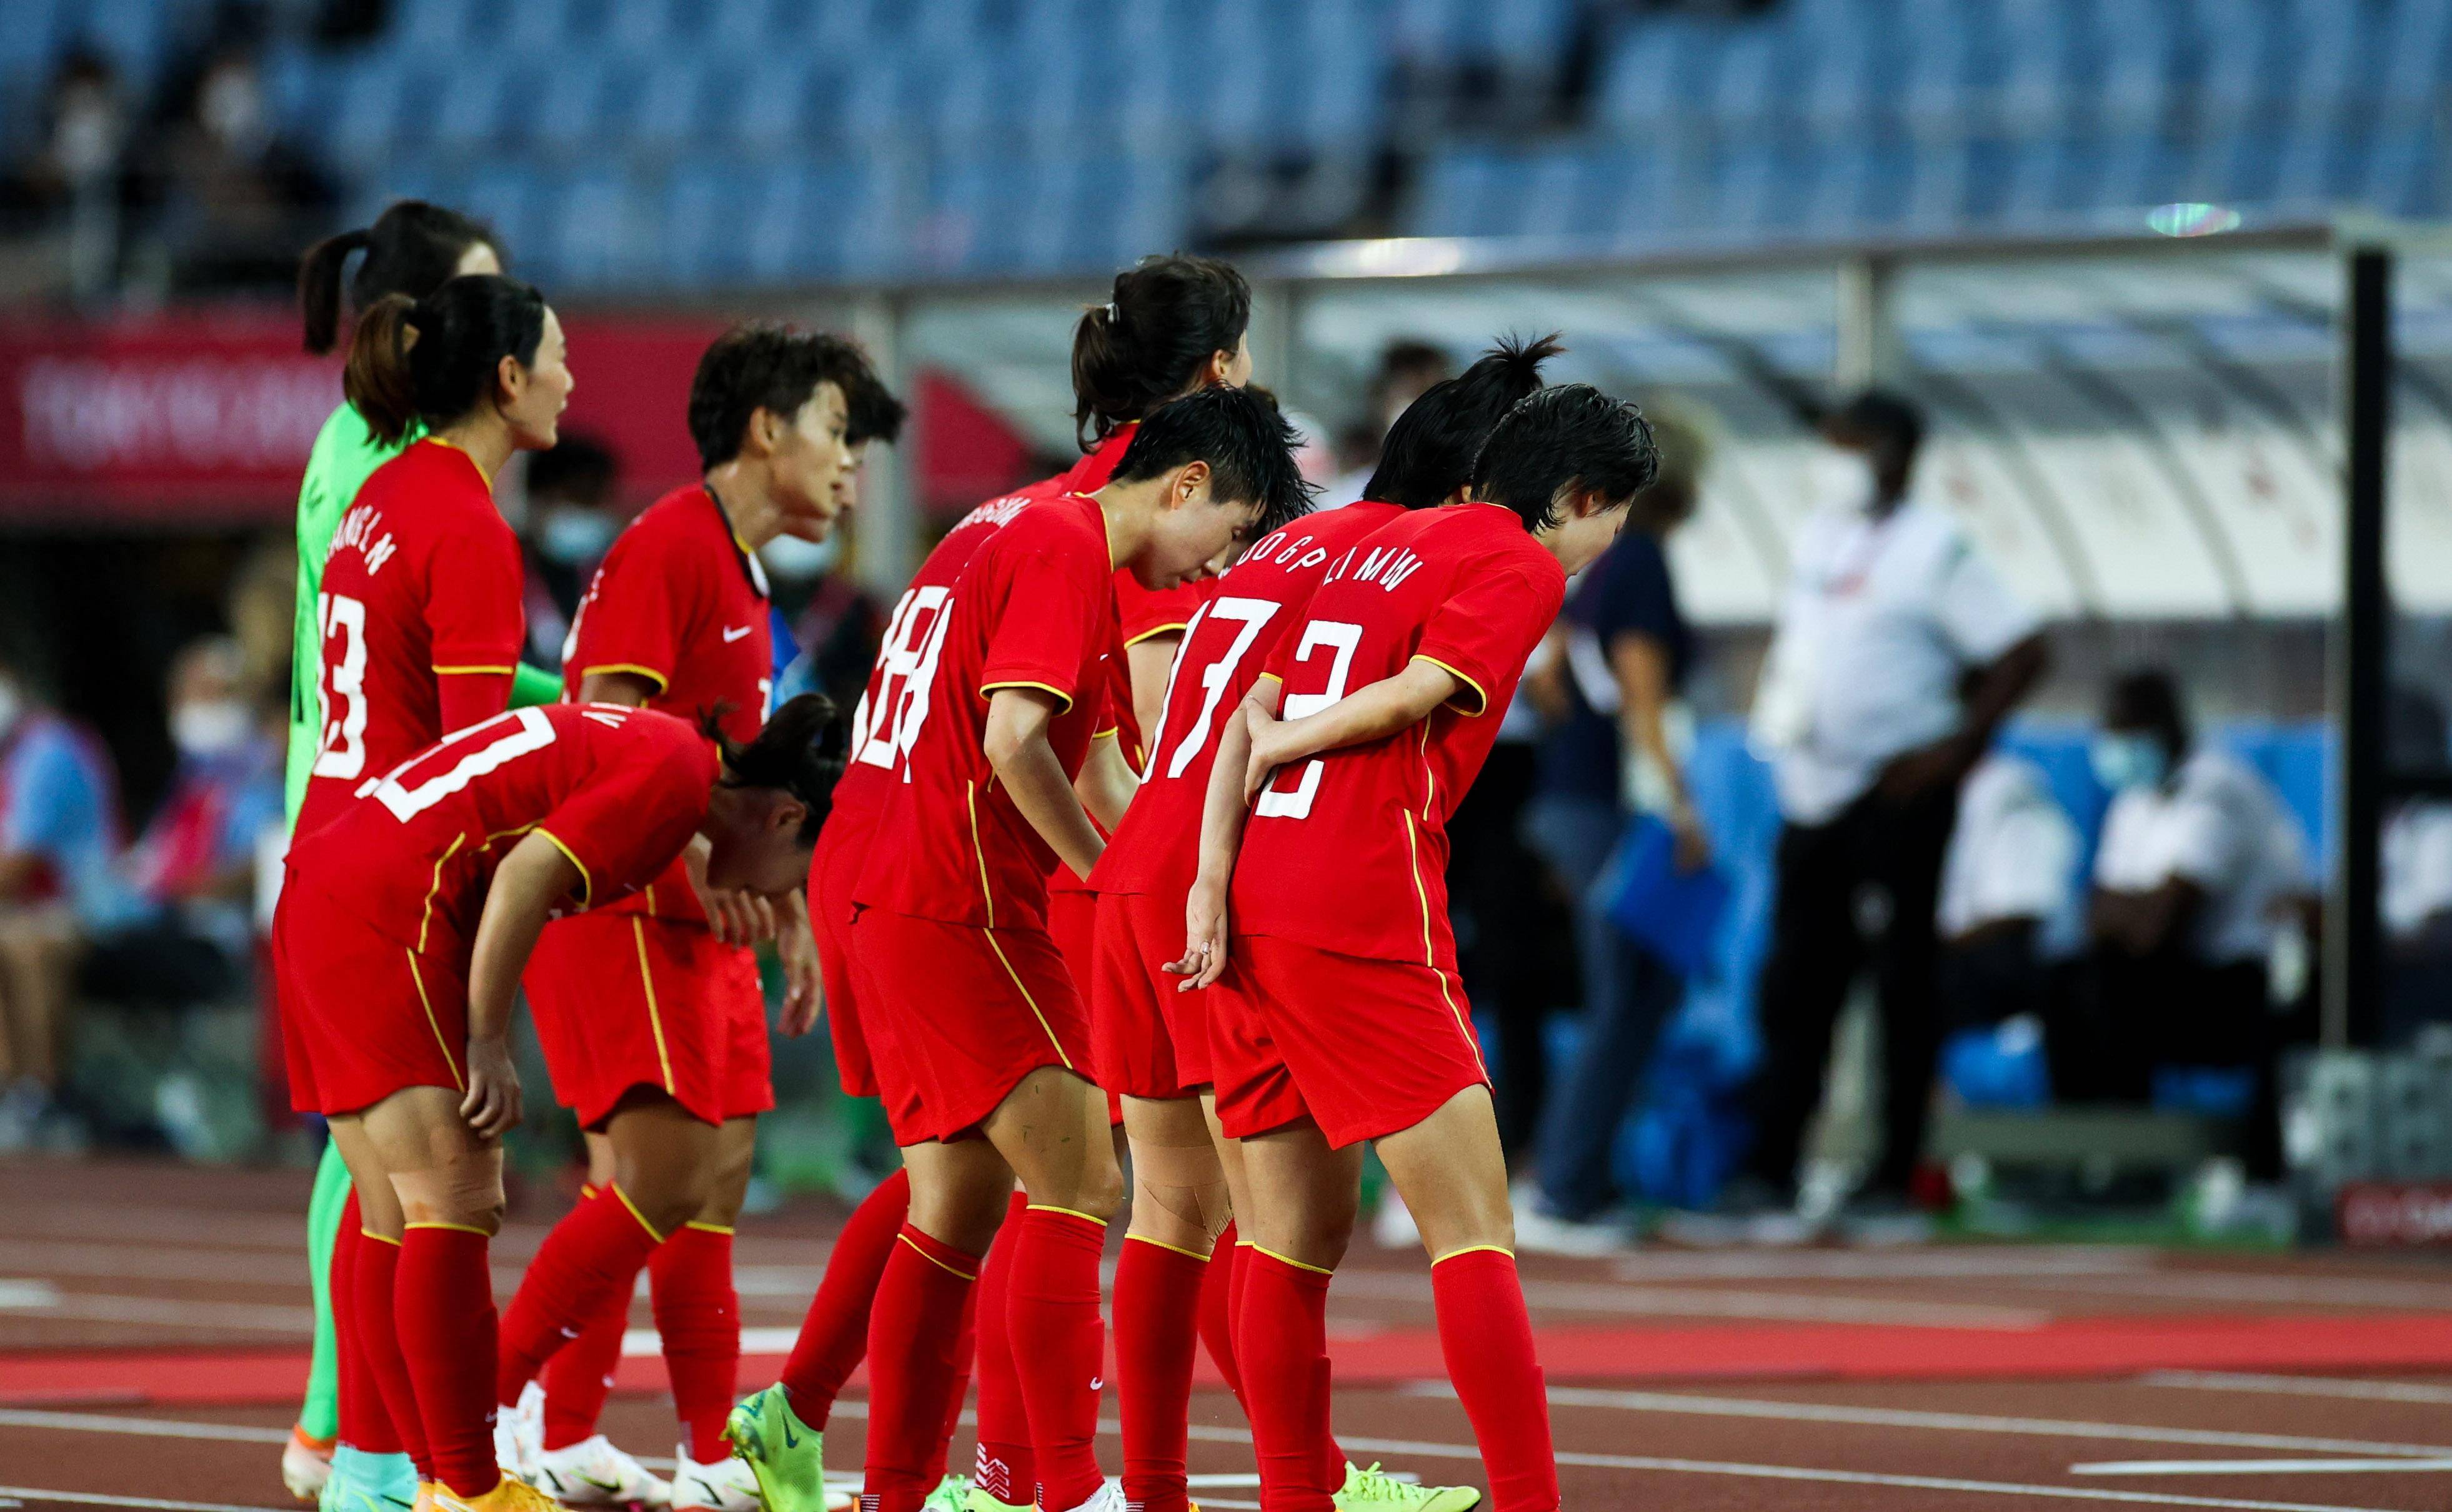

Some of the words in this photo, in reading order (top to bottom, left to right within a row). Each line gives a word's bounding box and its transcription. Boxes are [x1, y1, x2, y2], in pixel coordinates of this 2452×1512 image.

[1352, 546, 1423, 592] MW
[1141, 597, 1282, 784] 17
[1255, 620, 1362, 819] 2
